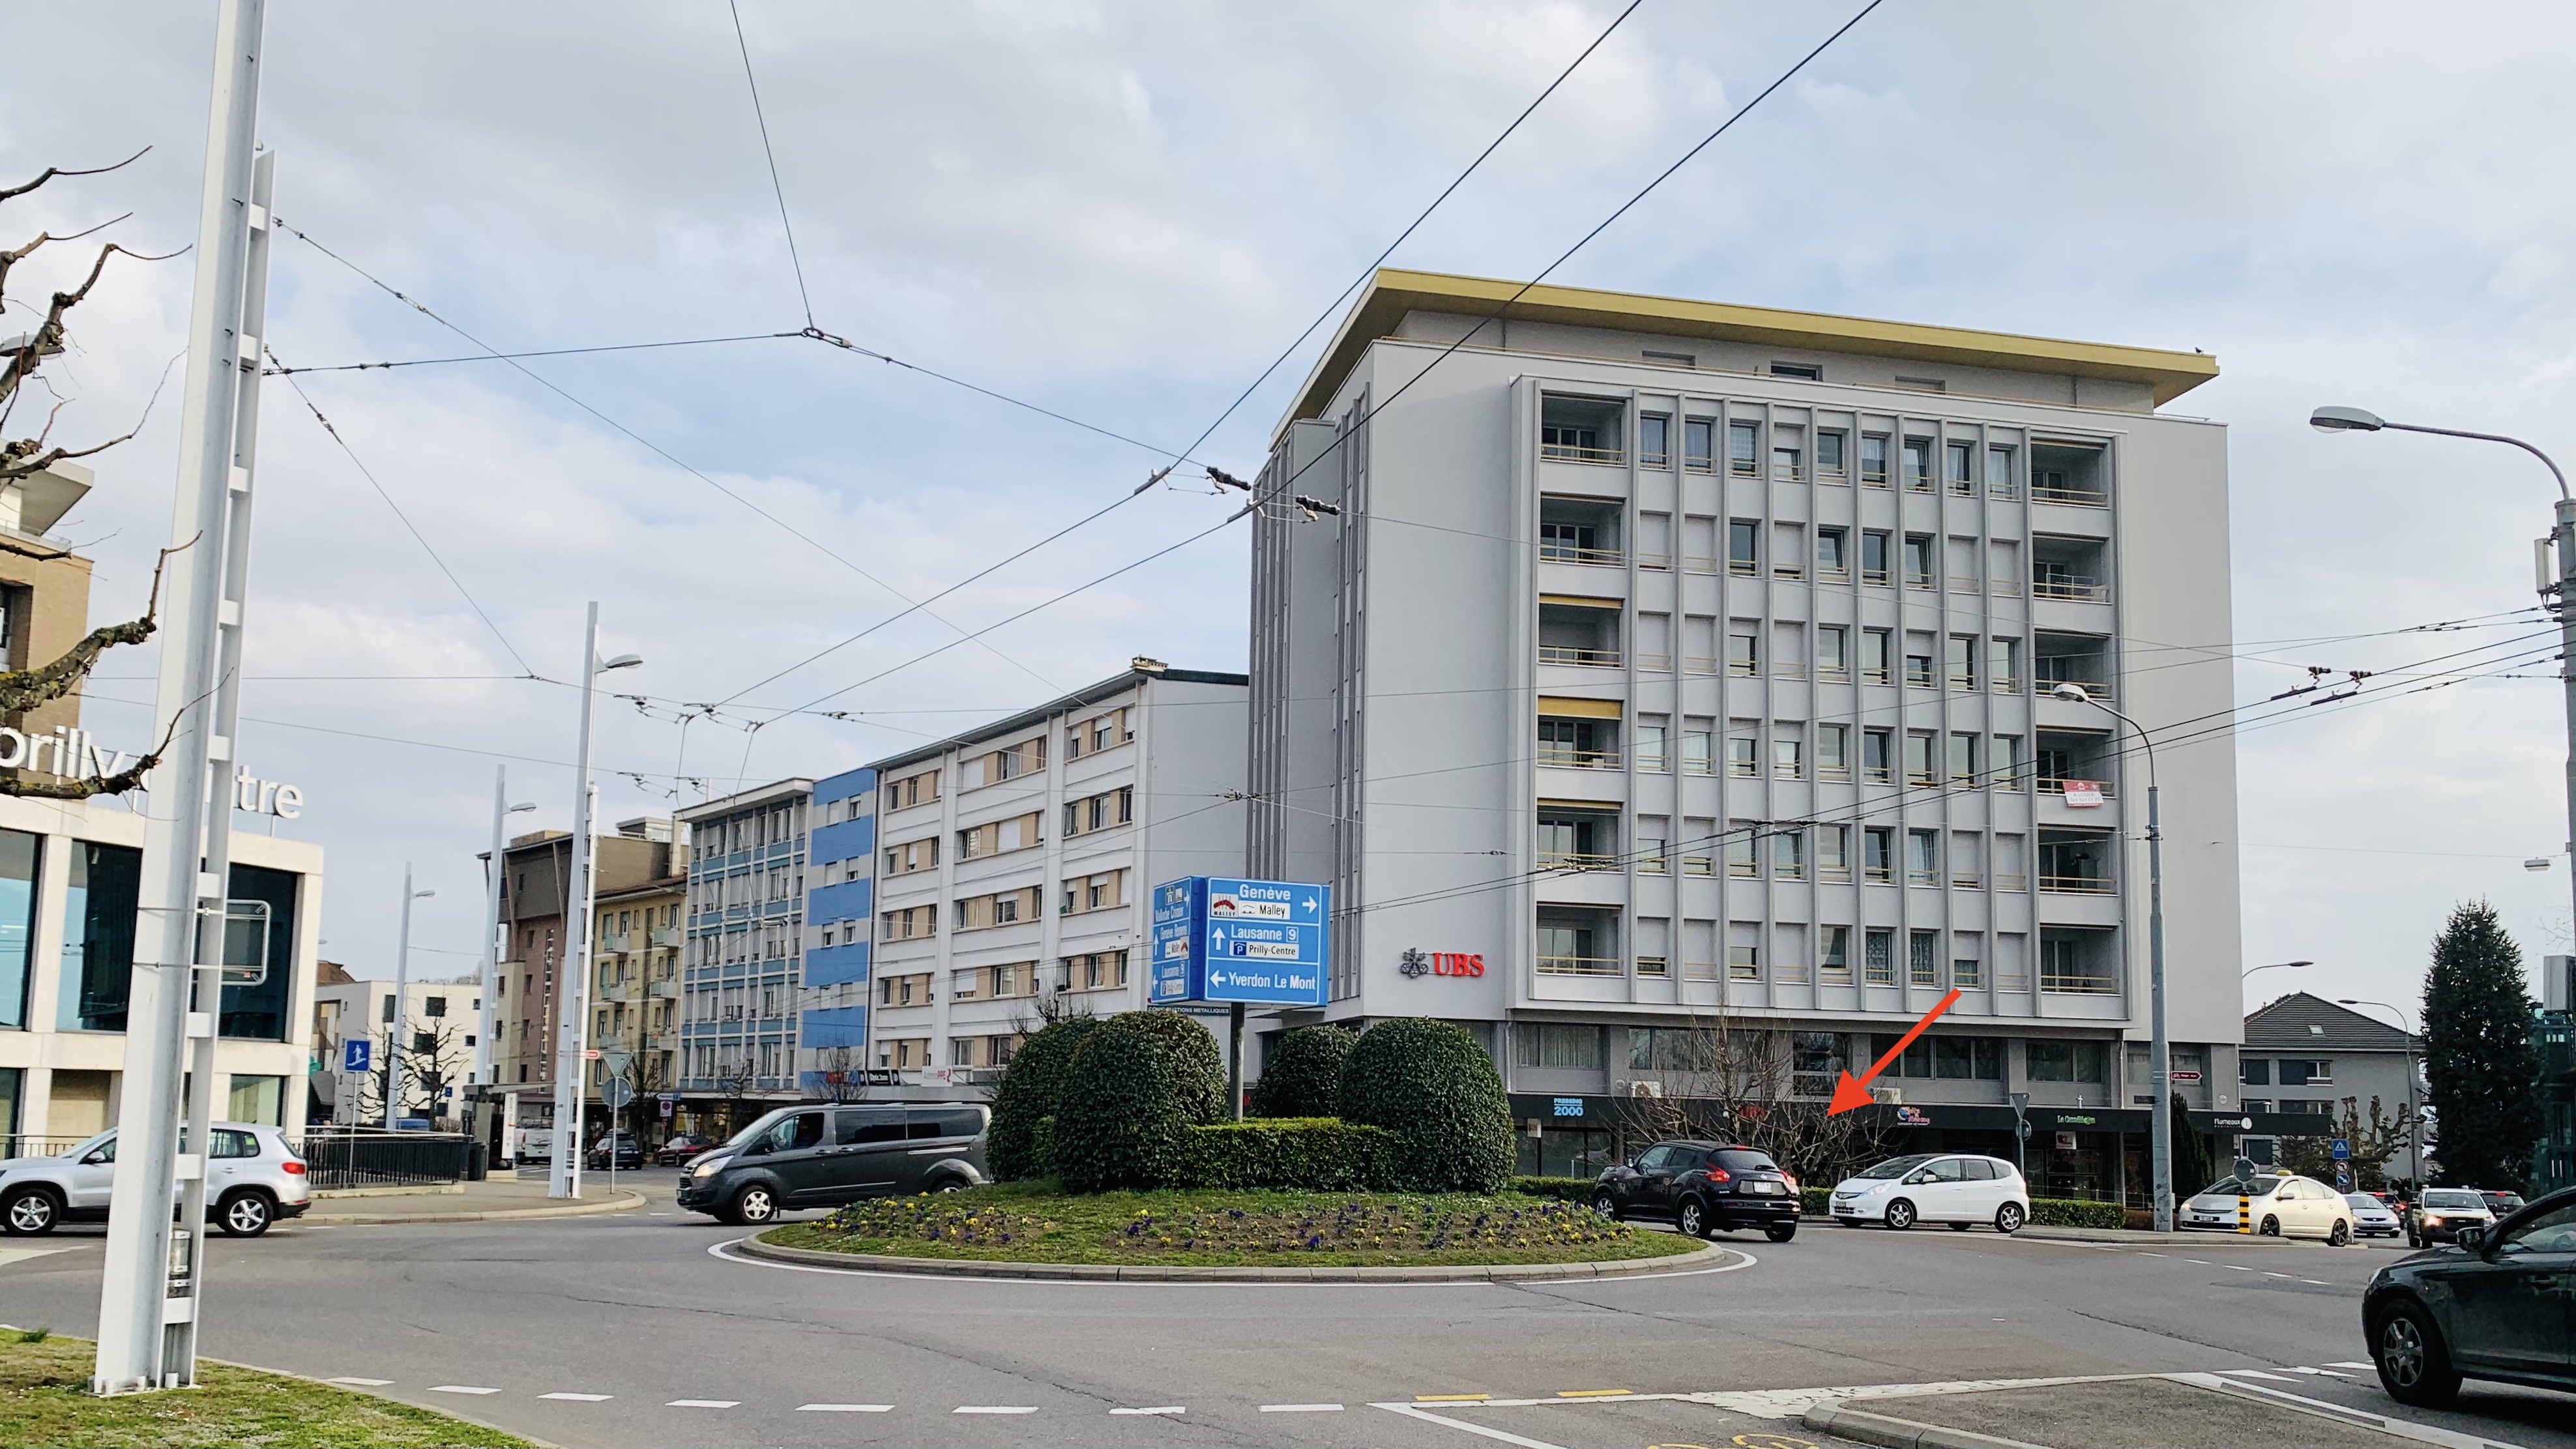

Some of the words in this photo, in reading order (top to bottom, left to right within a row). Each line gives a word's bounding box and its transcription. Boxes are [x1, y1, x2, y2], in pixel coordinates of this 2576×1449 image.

[1239, 884, 1291, 900] Genève
[1259, 904, 1285, 918] Malley
[1231, 924, 1282, 941] Lausanne
[1288, 929, 1296, 941] 9
[1250, 944, 1296, 956] Prilly-Centre
[1433, 952, 1485, 977] UBS
[1228, 971, 1270, 988] Yverdon
[1274, 974, 1287, 988] Le
[1290, 975, 1316, 989] Mont
[1553, 1106, 1584, 1117] 2000
